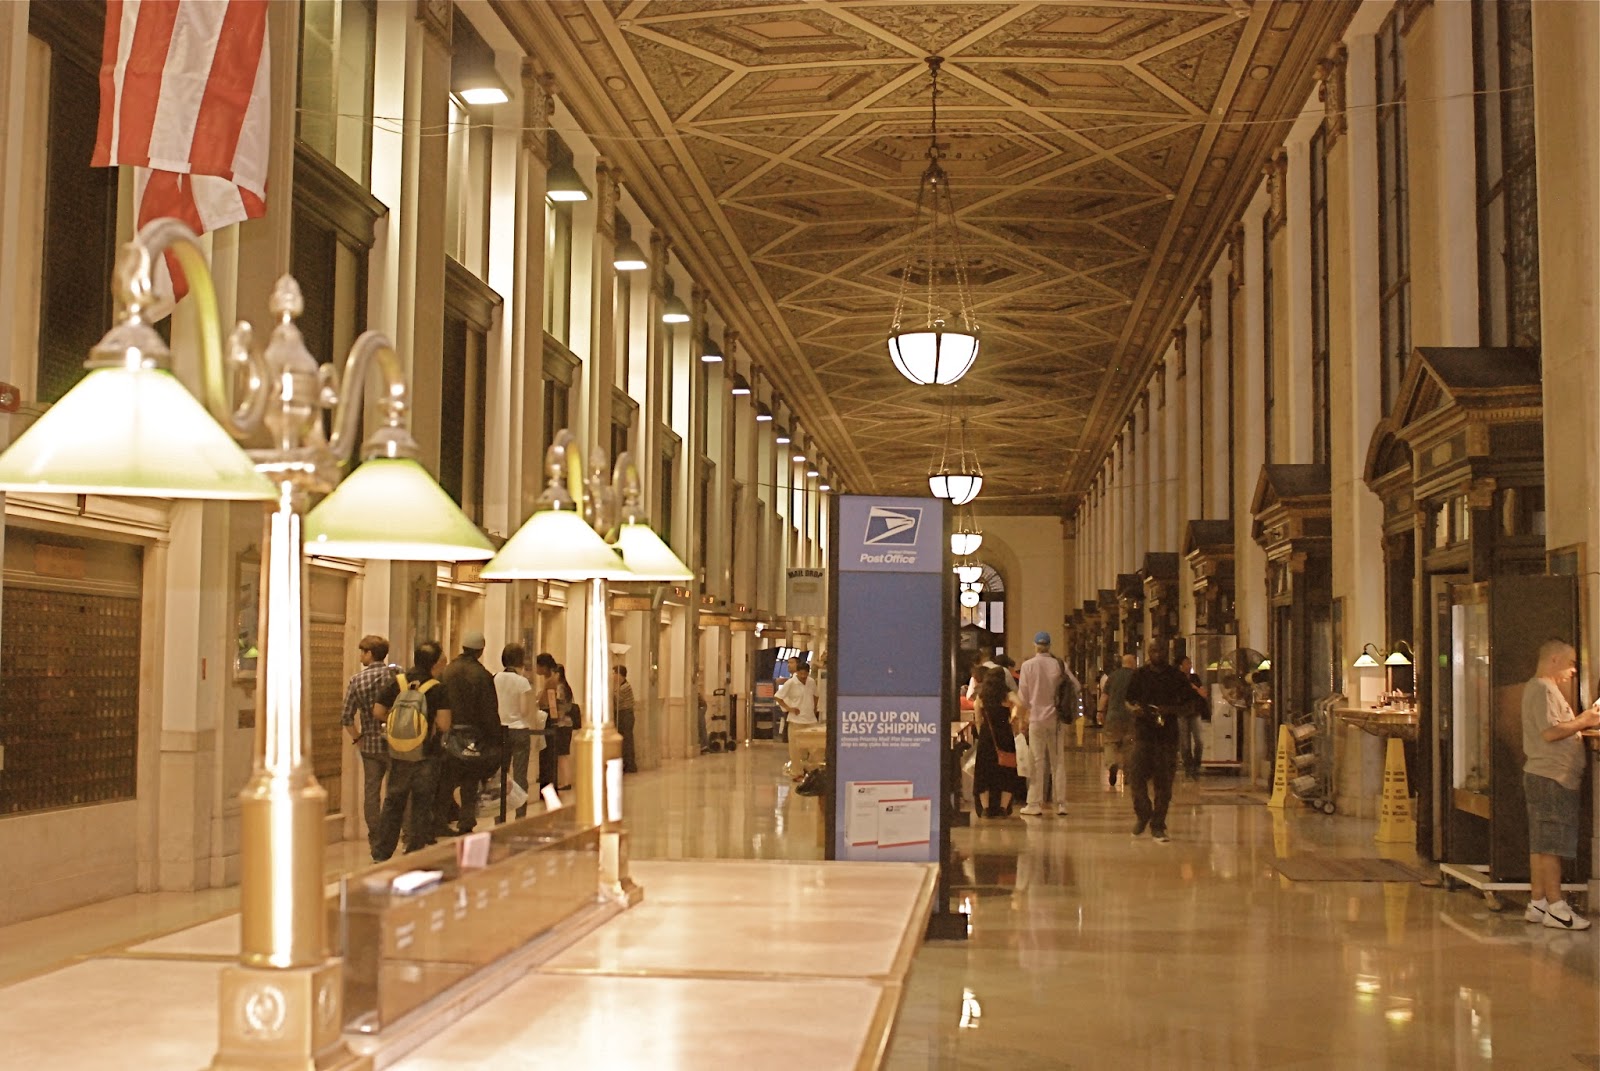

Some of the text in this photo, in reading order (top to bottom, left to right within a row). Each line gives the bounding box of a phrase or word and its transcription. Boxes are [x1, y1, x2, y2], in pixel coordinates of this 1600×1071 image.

[860, 553, 916, 564] Post Office
[788, 569, 823, 578] MAIL DROP
[842, 711, 920, 723] LOAD UP ON
[842, 722, 937, 735] EASY SHIPPING
